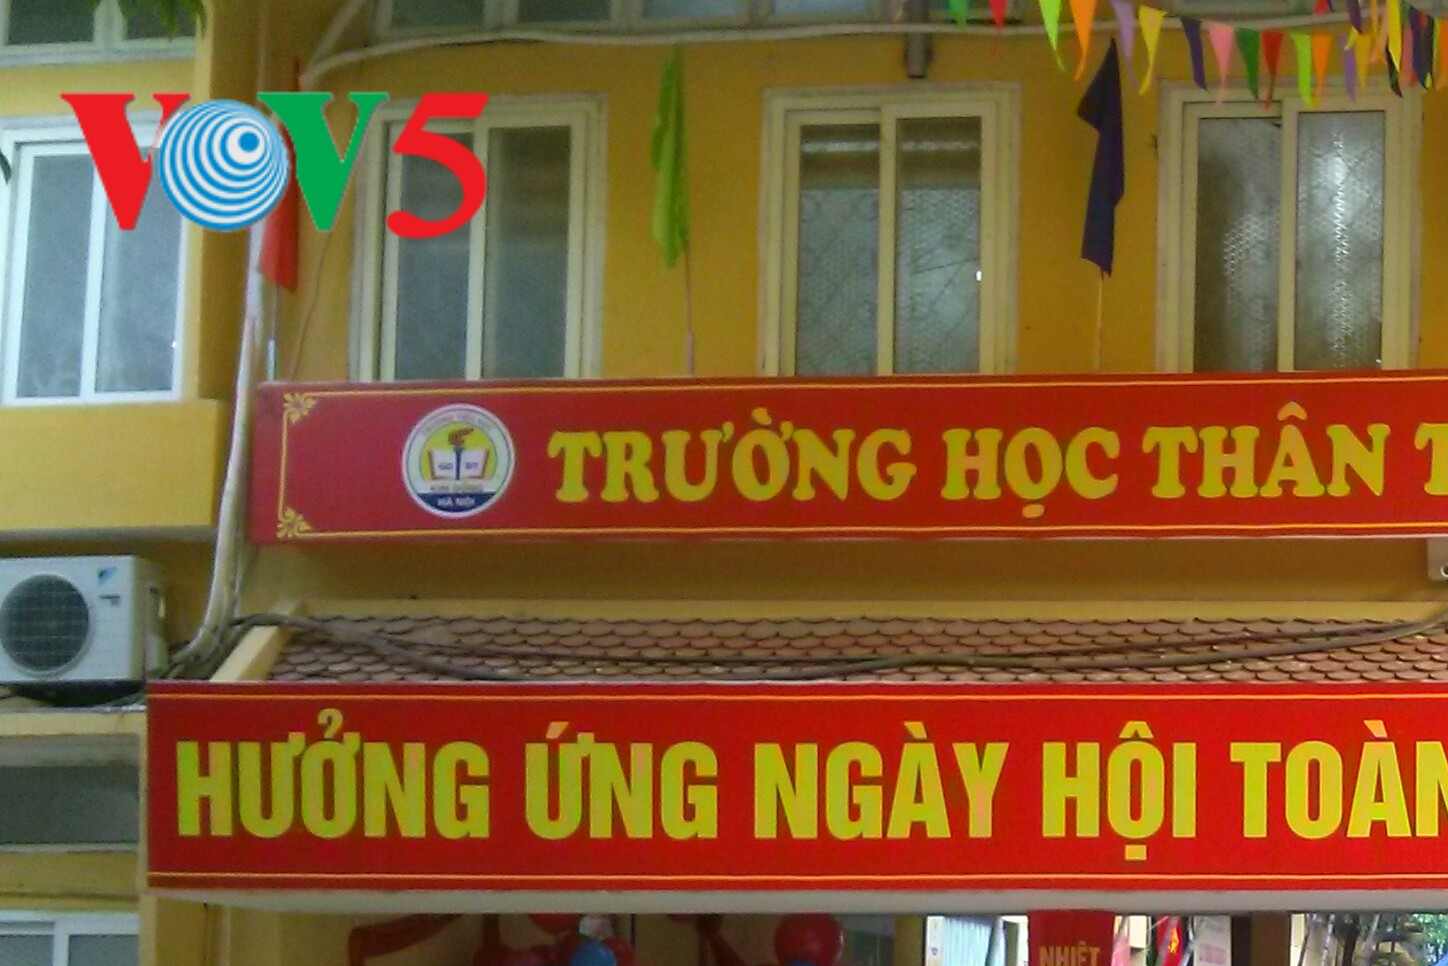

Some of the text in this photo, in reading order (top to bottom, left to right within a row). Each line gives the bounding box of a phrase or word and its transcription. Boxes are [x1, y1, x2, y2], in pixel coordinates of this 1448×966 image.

[547, 406, 917, 503] TRƯỜNG
[941, 427, 1119, 519] HỌC
[1142, 401, 1391, 499] THÂN
[175, 707, 492, 840] HƯỞNG
[524, 721, 718, 841] ỨNG
[753, 721, 1009, 840] NGÀY
[1042, 720, 1198, 861] HỘI
